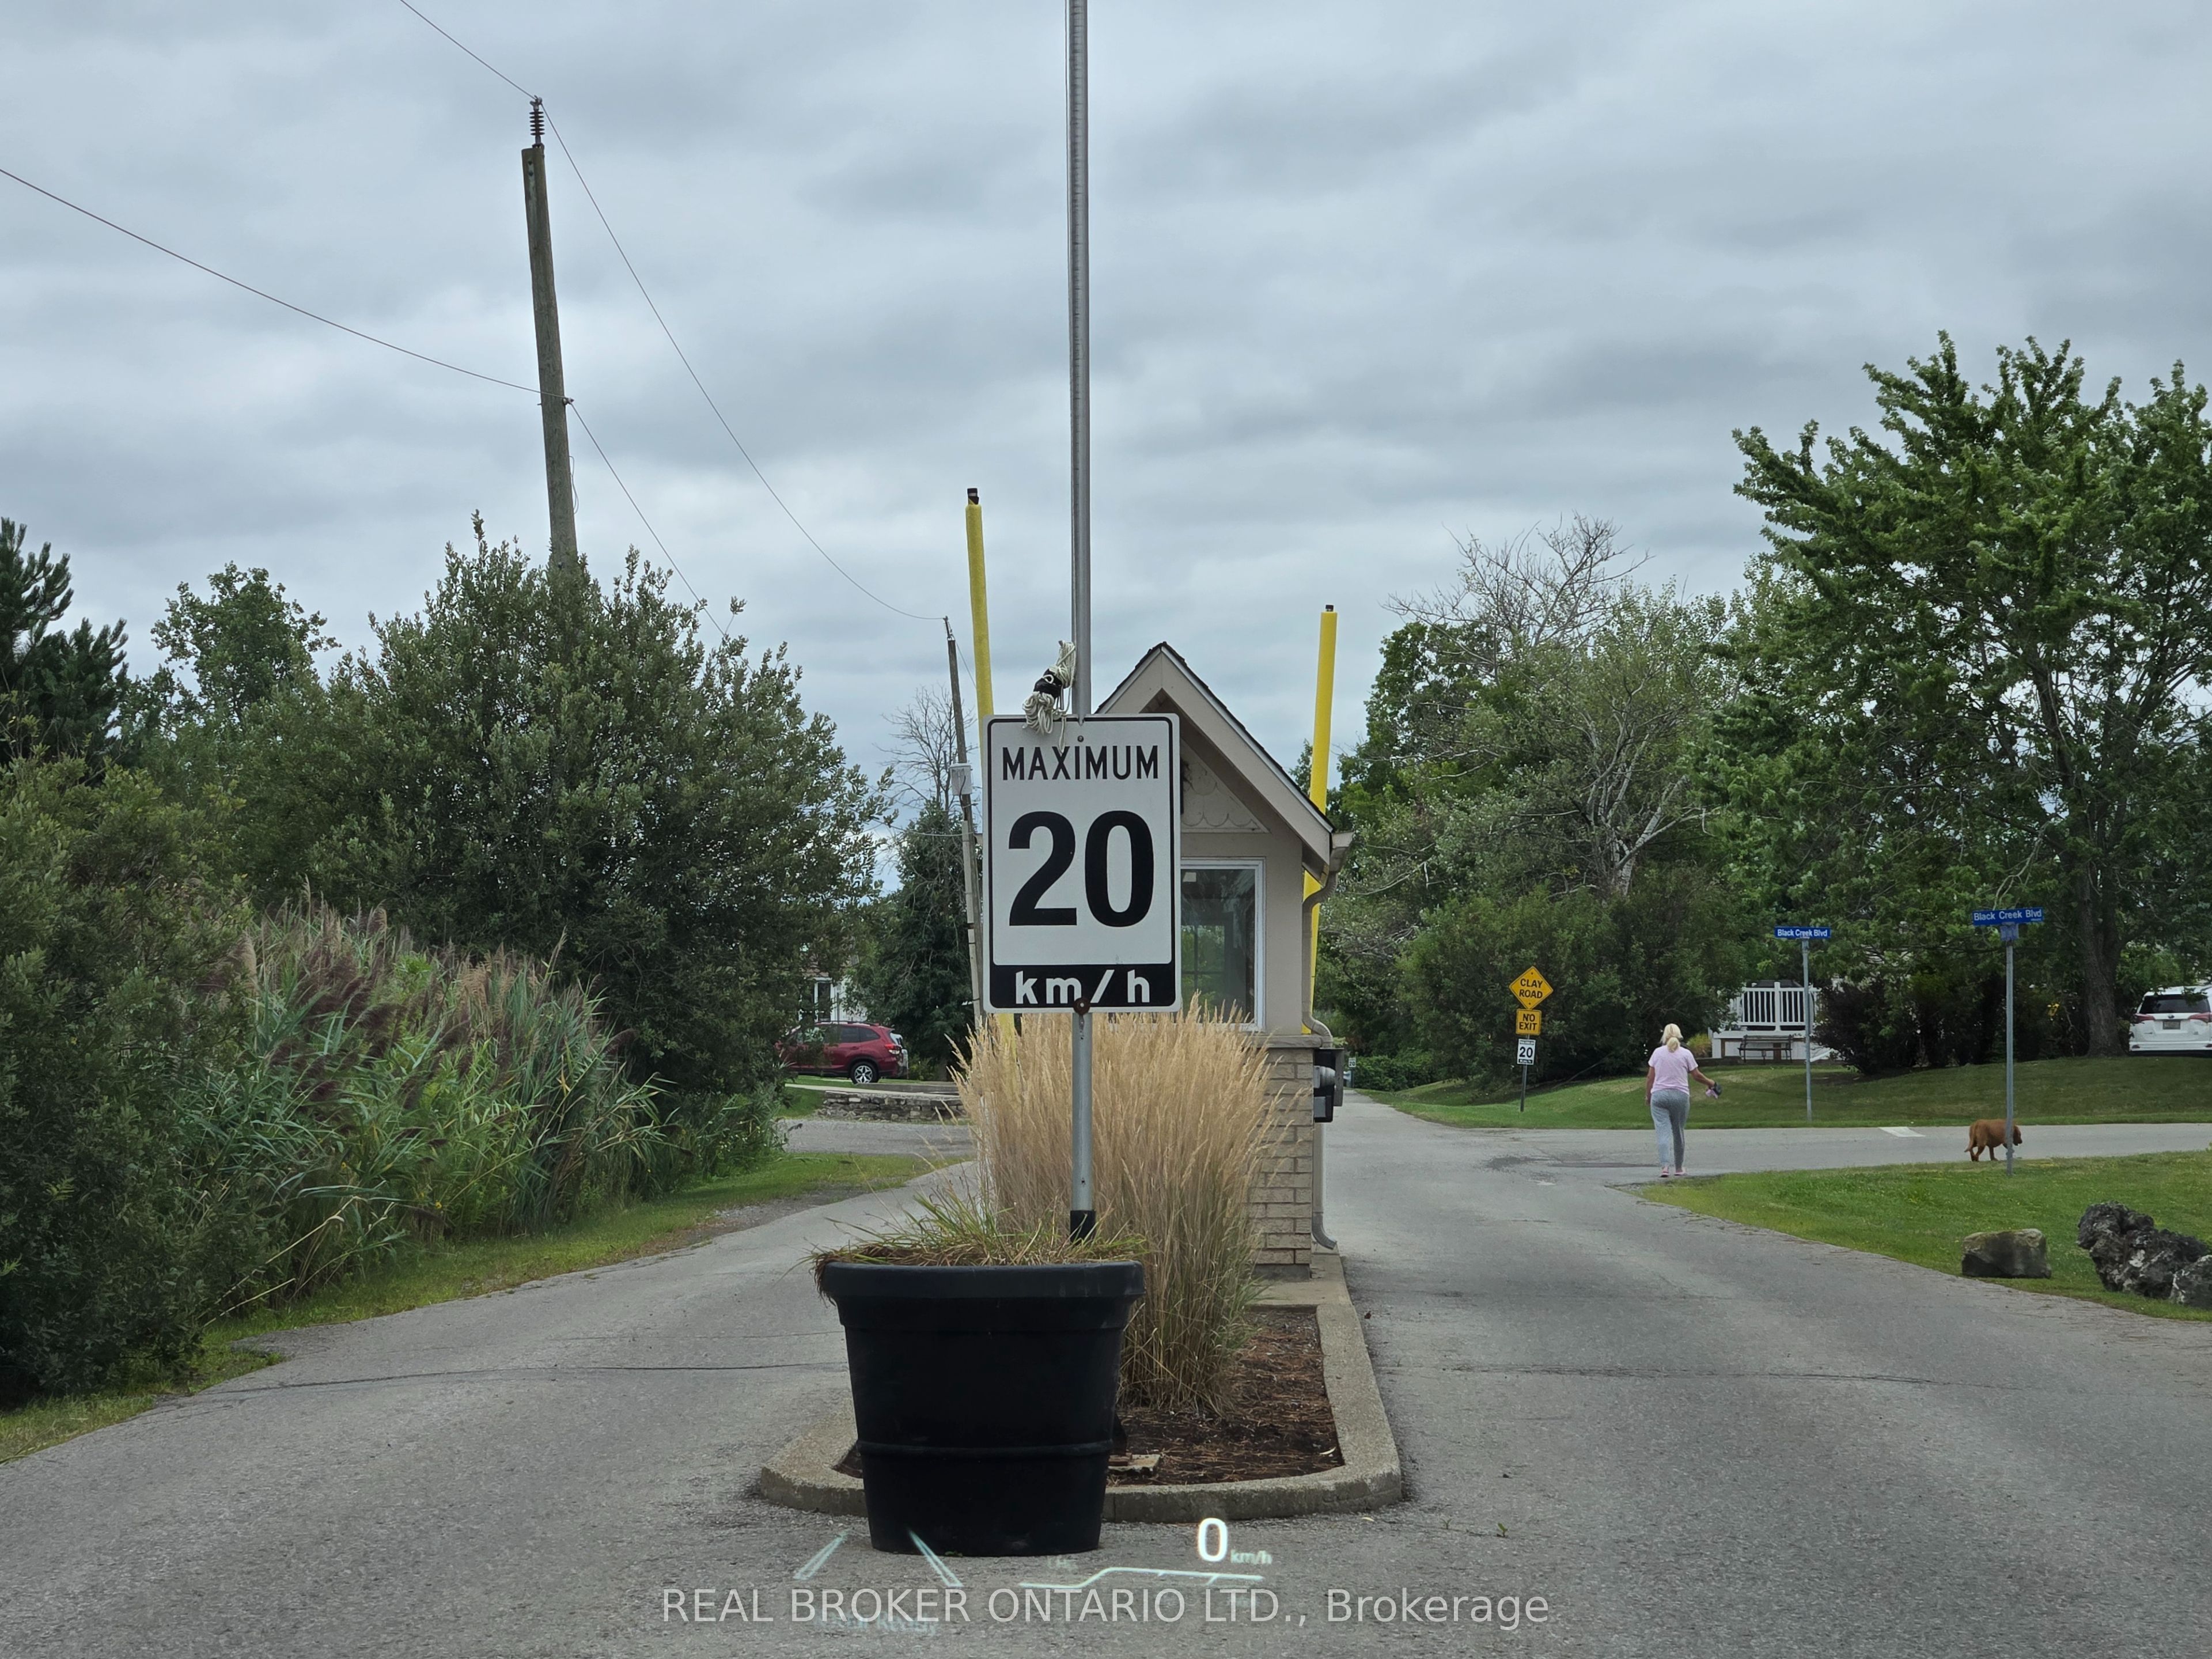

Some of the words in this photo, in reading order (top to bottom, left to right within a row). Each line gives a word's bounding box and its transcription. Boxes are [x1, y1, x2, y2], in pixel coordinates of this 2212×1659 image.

[1002, 745, 1158, 780] MAXIMUM
[1009, 810, 1154, 927] 20
[1974, 912, 1995, 921] Black
[1999, 911, 2022, 919] Creek
[2025, 909, 2042, 918] Blvd
[1015, 969, 1150, 1005] km/h
[1520, 979, 1543, 988] CLAY
[1519, 990, 1543, 998] ROAD
[1522, 1013, 1535, 1022] NO
[1519, 1022, 1537, 1031] EXIT
[1519, 1046, 1533, 1058] 20
[1198, 1517, 1228, 1562] 0
[1230, 1549, 1272, 1565] km/h
